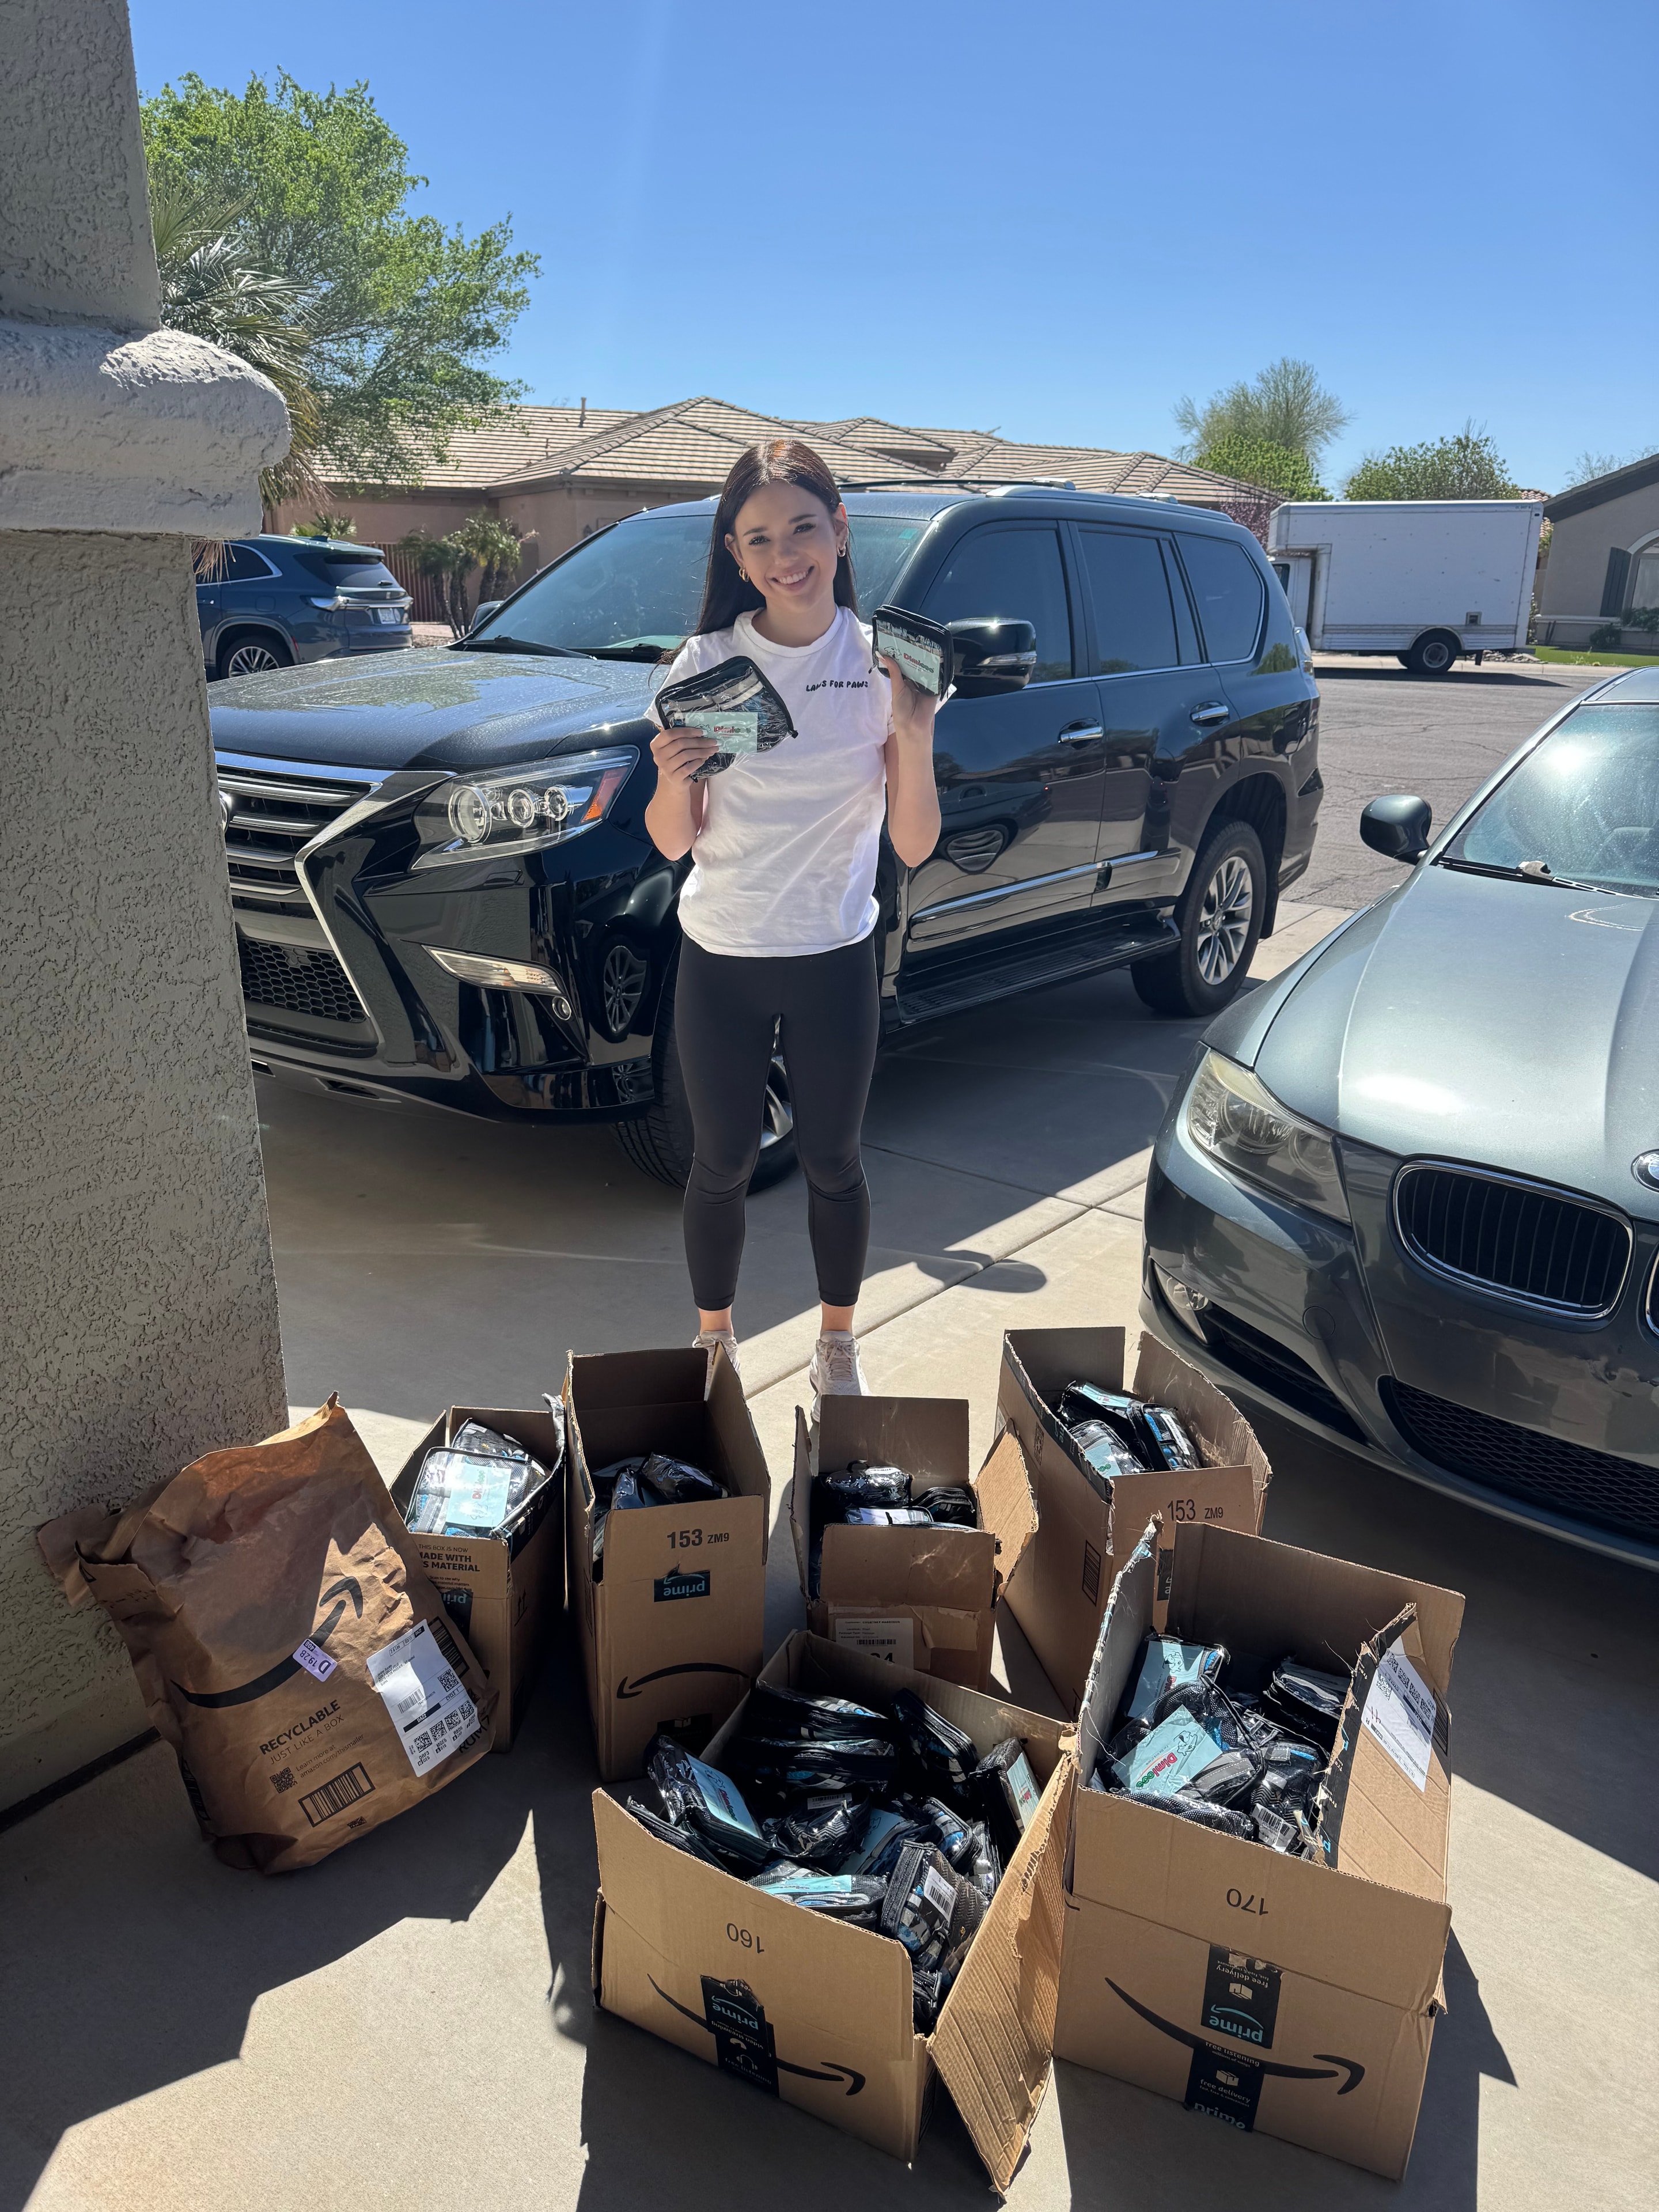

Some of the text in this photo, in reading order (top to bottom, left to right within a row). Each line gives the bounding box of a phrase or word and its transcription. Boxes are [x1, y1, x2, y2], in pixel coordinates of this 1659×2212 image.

[830, 680, 843, 688] FOR
[1167, 1499, 1223, 1521] 153 ZM9
[667, 1528, 729, 1548] 153 ZM9
[431, 1562, 480, 1572] MATERIAL
[445, 1554, 472, 1562] WITH
[663, 1580, 705, 1596] prime
[305, 1641, 316, 1651] 408
[300, 1650, 332, 1675] D 19.2B
[259, 1699, 341, 1755] RECYCLABLE
[270, 1714, 344, 1765] JUST LIKE A BOX
[296, 1759, 313, 1771] Learn
[313, 1749, 328, 1761] more
[300, 1734, 364, 1778] amazon.com/thismailer
[1226, 1888, 1268, 1915] 170
[726, 1923, 765, 1954] 160
[1216, 1964, 1268, 1988] free delivery
[712, 2003, 759, 2030] prime
[711, 2020, 744, 2039] streaming
[1209, 2016, 1263, 2043] prime
[1224, 2048, 1260, 2067] listening
[1200, 2079, 1251, 2103] free delivery
